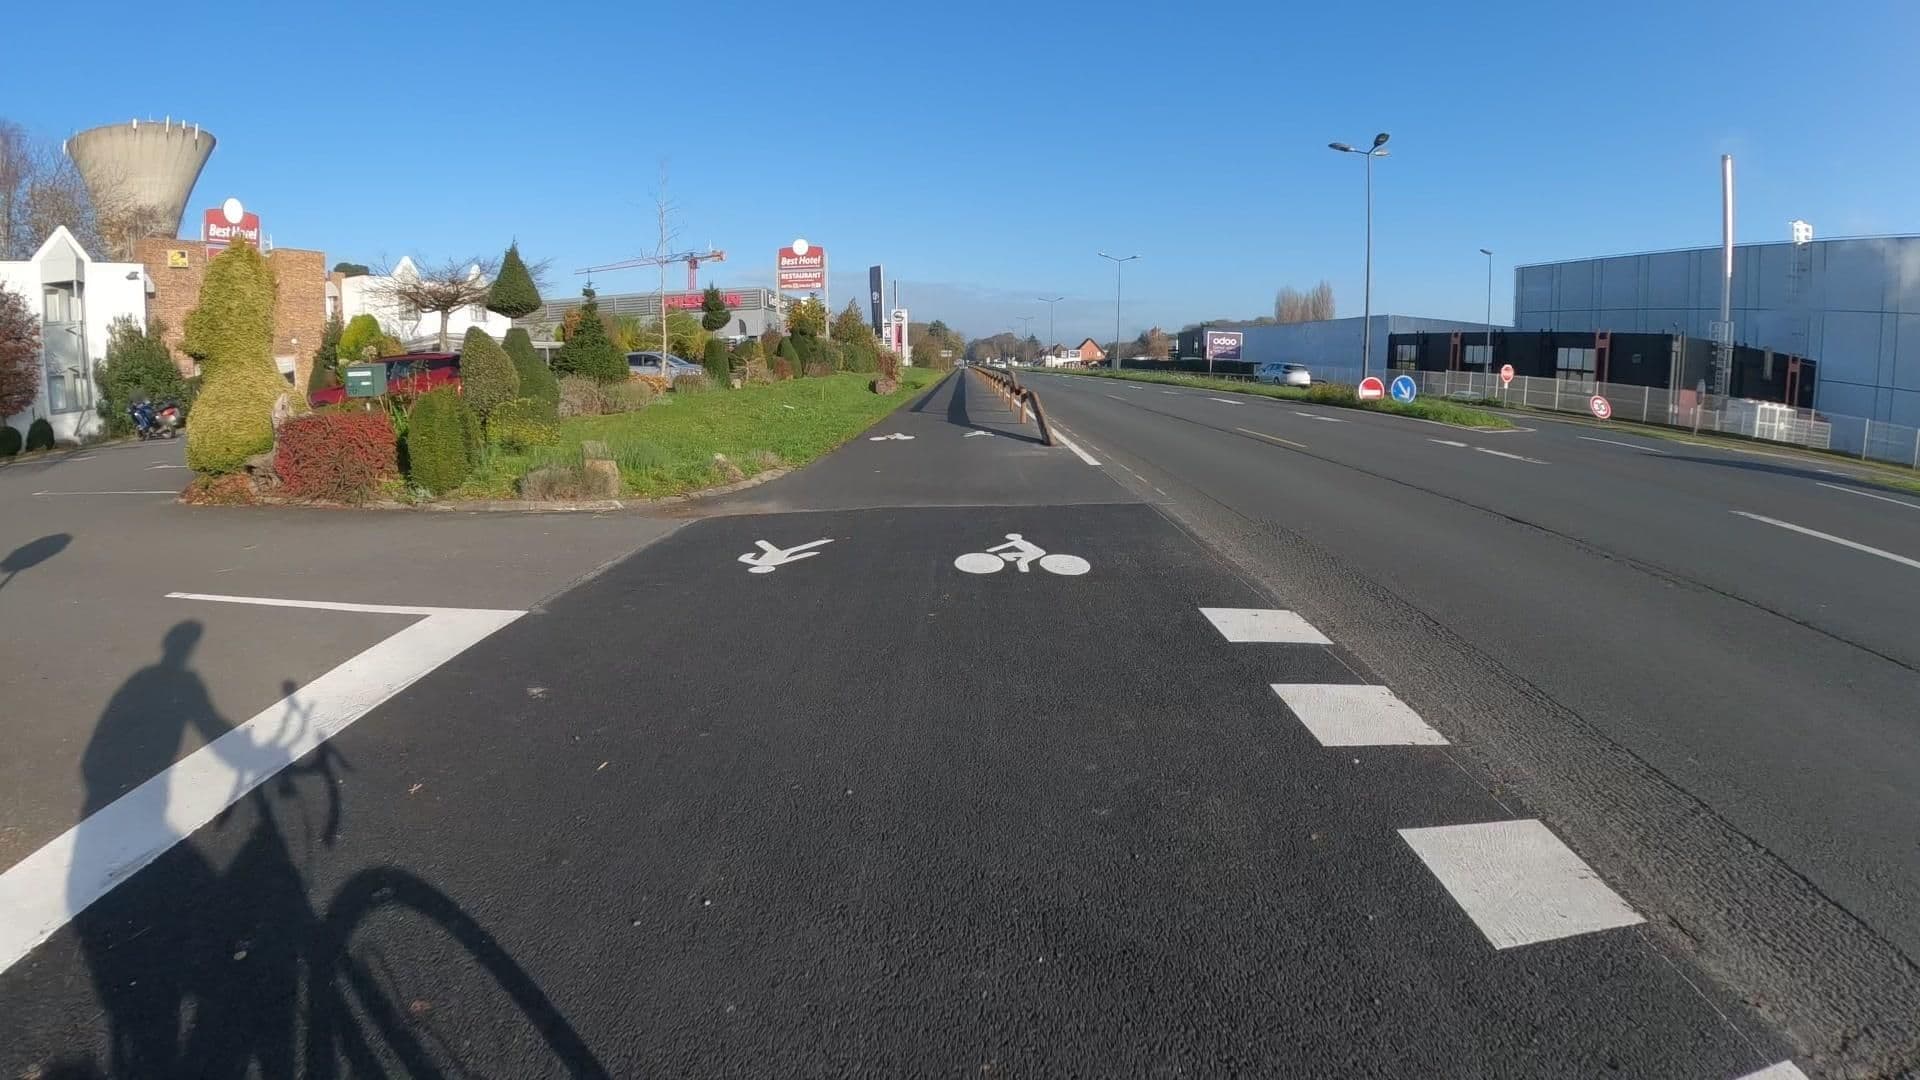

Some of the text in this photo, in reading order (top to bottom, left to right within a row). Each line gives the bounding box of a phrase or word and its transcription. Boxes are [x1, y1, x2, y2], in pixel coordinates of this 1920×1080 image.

[209, 224, 230, 238] Best
[781, 255, 821, 266] Best Hotel
[781, 272, 821, 280] RESTAURANT
[1213, 336, 1237, 346] odoo
